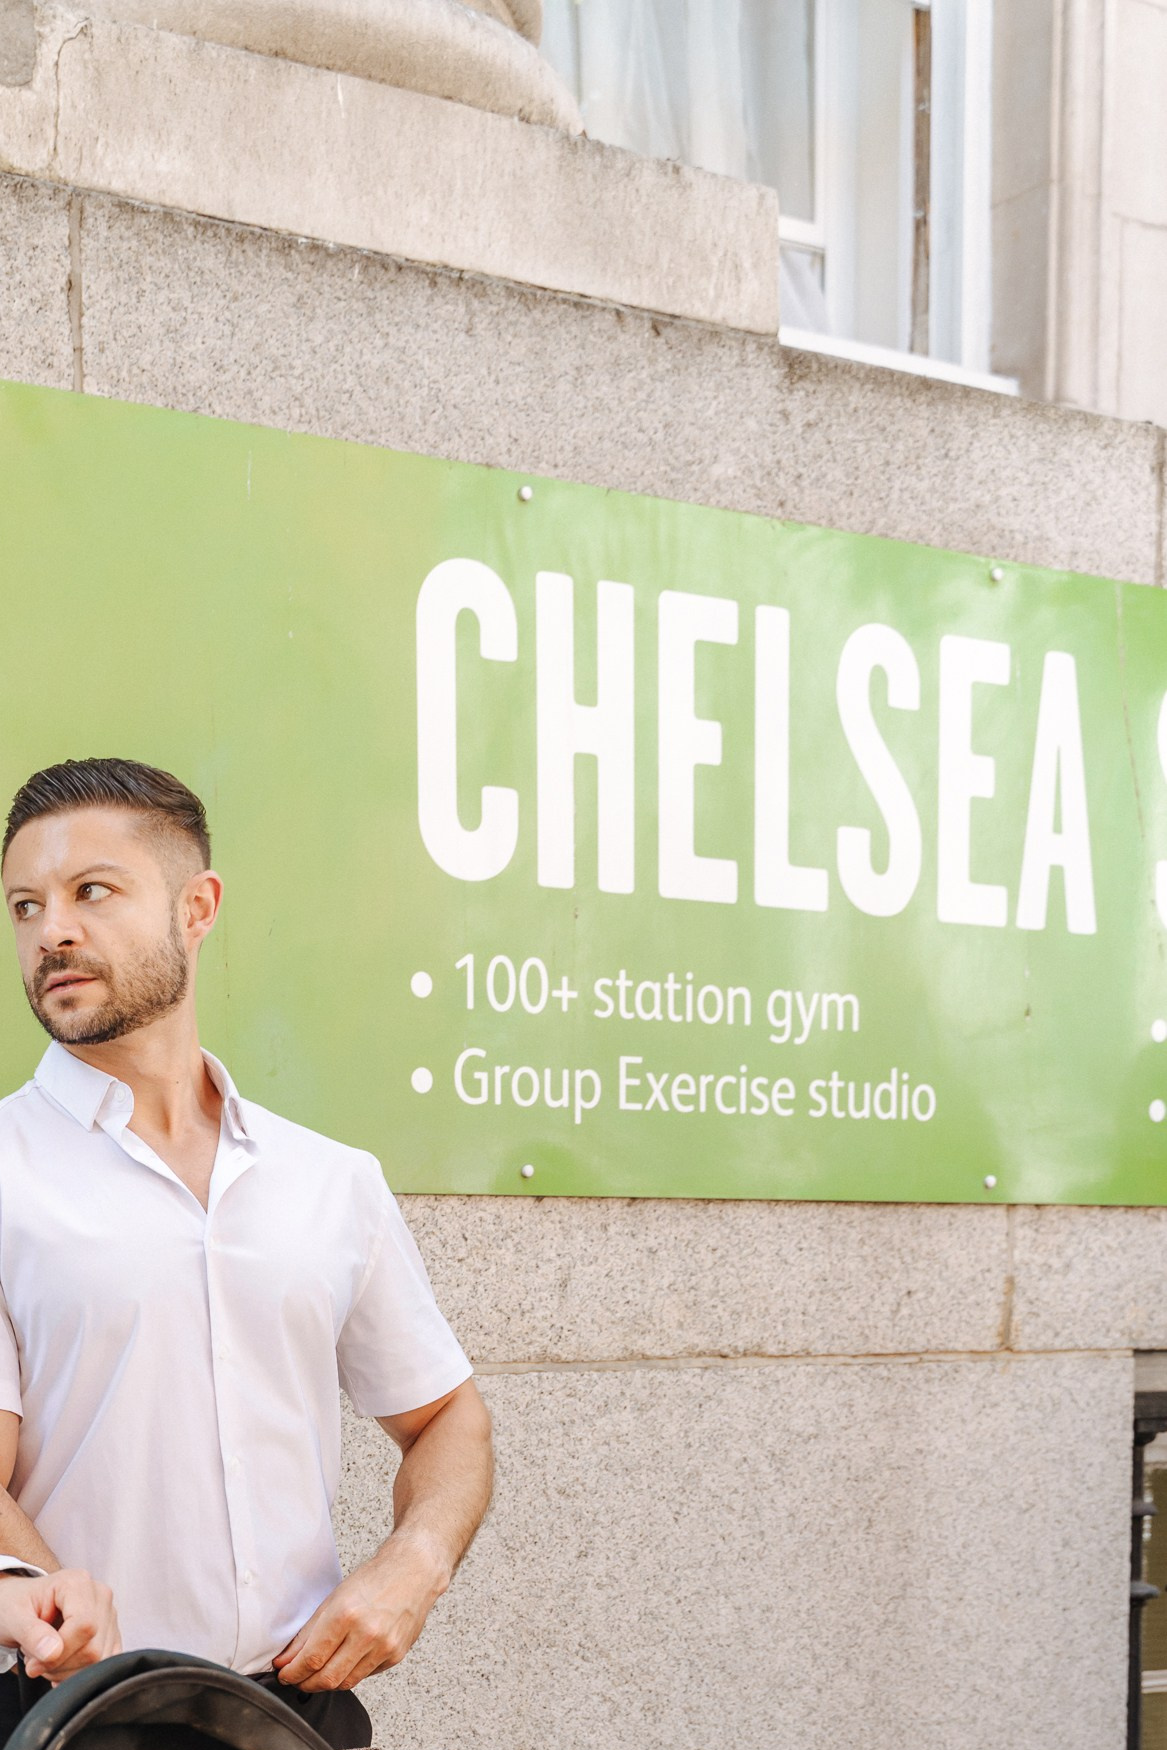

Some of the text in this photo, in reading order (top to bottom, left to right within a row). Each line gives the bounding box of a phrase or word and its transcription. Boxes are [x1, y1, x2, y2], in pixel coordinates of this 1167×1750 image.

[415, 557, 1098, 936] CHELSEA
[454, 952, 861, 1046] 100+ station gym
[453, 1046, 938, 1126] Group Exercise studio
